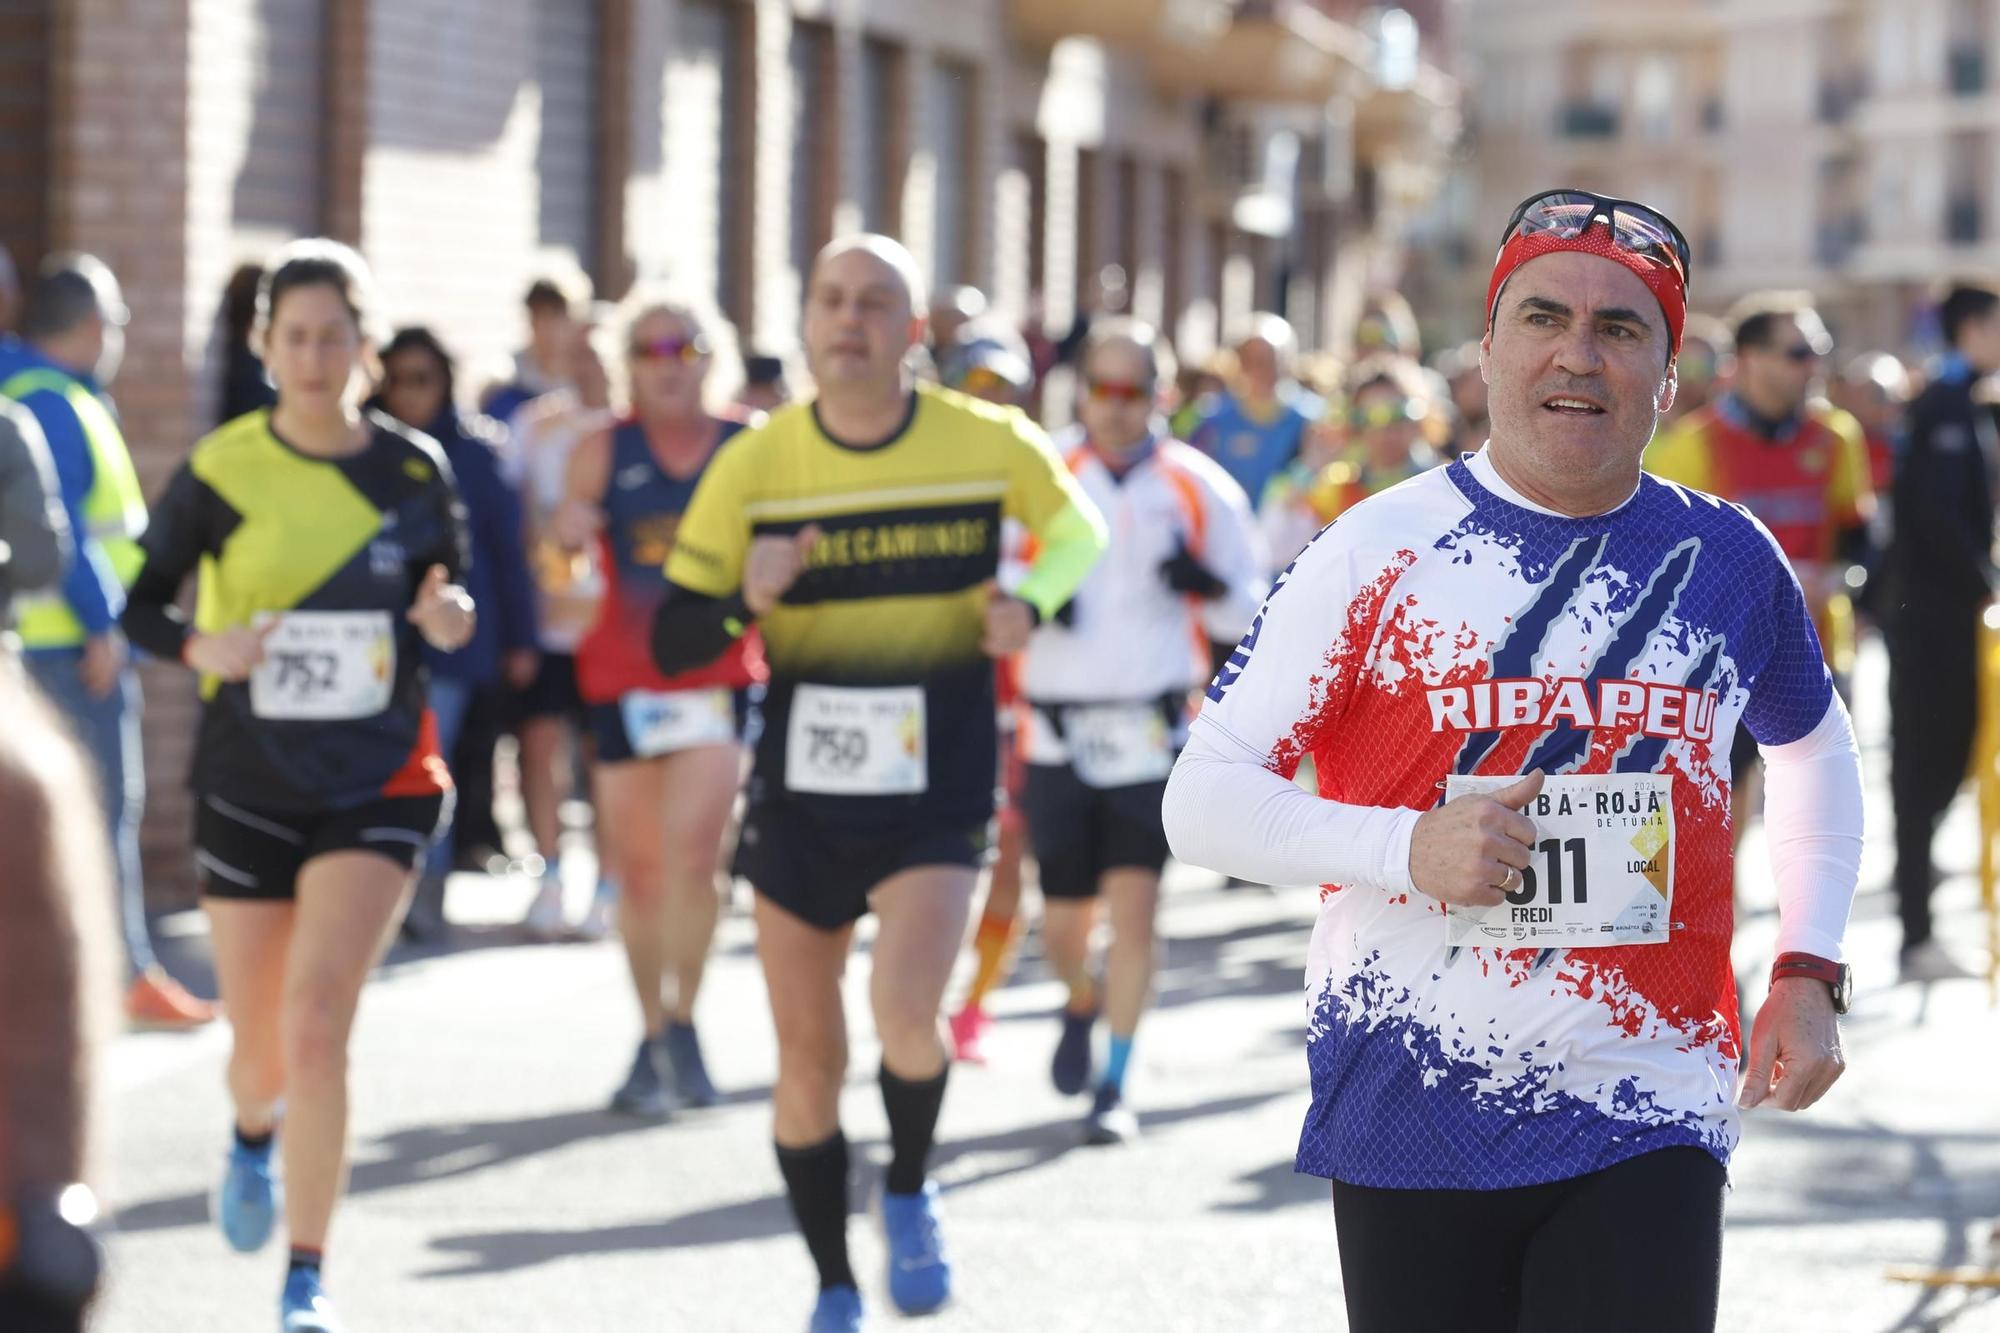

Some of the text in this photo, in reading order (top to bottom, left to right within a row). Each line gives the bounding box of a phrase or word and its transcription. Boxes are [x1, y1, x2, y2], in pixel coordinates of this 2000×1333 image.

[1425, 678, 1718, 740] RIBAPEU
[1634, 782, 1656, 791] 2024
[1597, 815, 1663, 828] DE TÚRIA
[1627, 860, 1660, 873] LOCAL
[1511, 907, 1552, 922] FREDI
